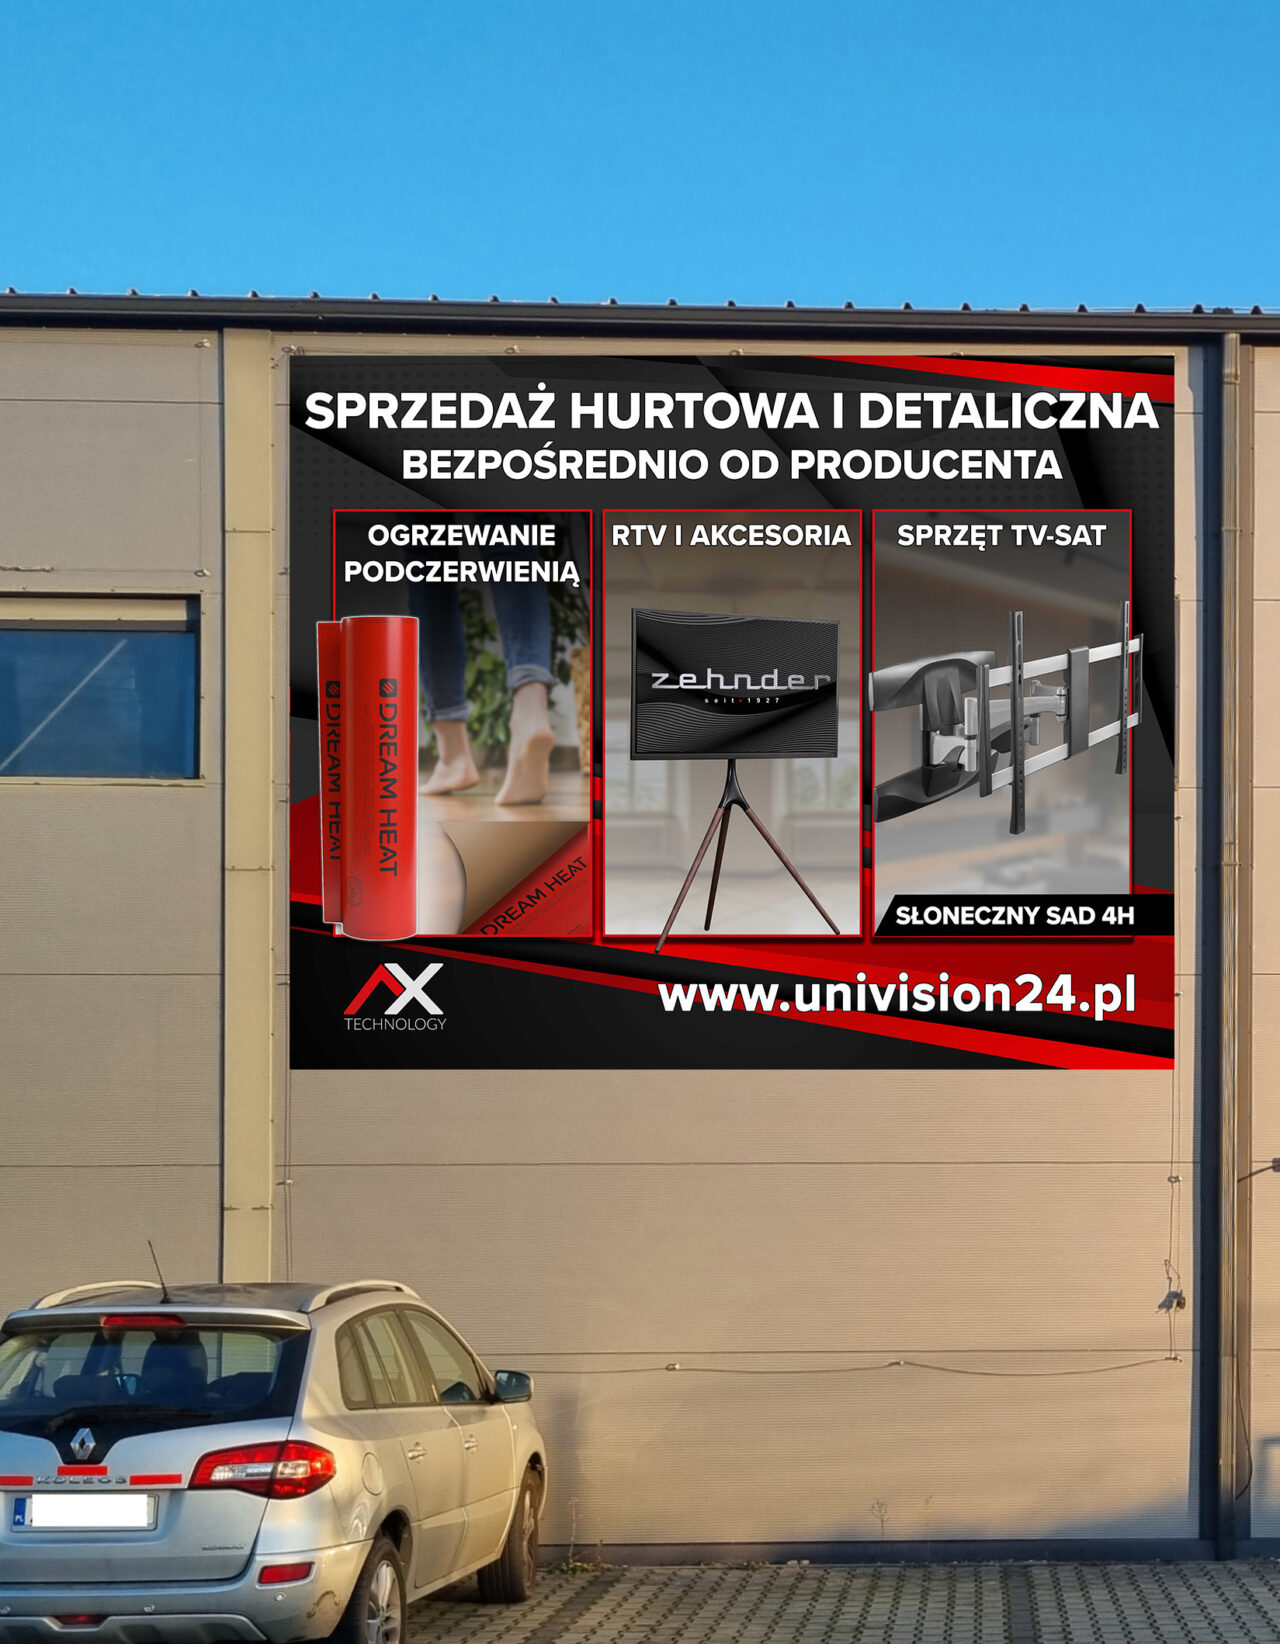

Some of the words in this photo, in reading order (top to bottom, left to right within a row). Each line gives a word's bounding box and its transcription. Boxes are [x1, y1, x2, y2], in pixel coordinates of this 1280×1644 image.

[305, 381, 556, 430] SPRZEDAŻ
[571, 391, 820, 430] HURTOWA
[833, 392, 843, 429] I
[860, 391, 1160, 430] DETALICZNA
[403, 441, 709, 480] BEZPOŚREDNIO
[719, 449, 779, 480] OD
[791, 449, 1063, 480] PRODUCENTA
[368, 524, 556, 546] OGRZEWANIE
[612, 524, 668, 546] RTV
[675, 524, 682, 546] I
[689, 524, 852, 546] AKCESORIA
[897, 524, 1004, 552] SPRZĘT
[1010, 524, 1107, 546] TV-SAT
[344, 560, 581, 588] PODCZERWIENIĄ
[651, 667, 832, 690] zehnder
[379, 703, 398, 799] DREAM
[379, 809, 398, 877] HEAT
[479, 888, 548, 935] DREAM
[543, 856, 587, 892] HEAT
[895, 906, 1041, 925] SŁONECZNY
[1046, 906, 1096, 925] SAD
[1101, 906, 1135, 925] 4H
[657, 971, 1135, 1022] www.univision24.pl
[344, 1017, 447, 1031] TECHNOLOGY
[36, 1475, 127, 1485] KOLEOS
